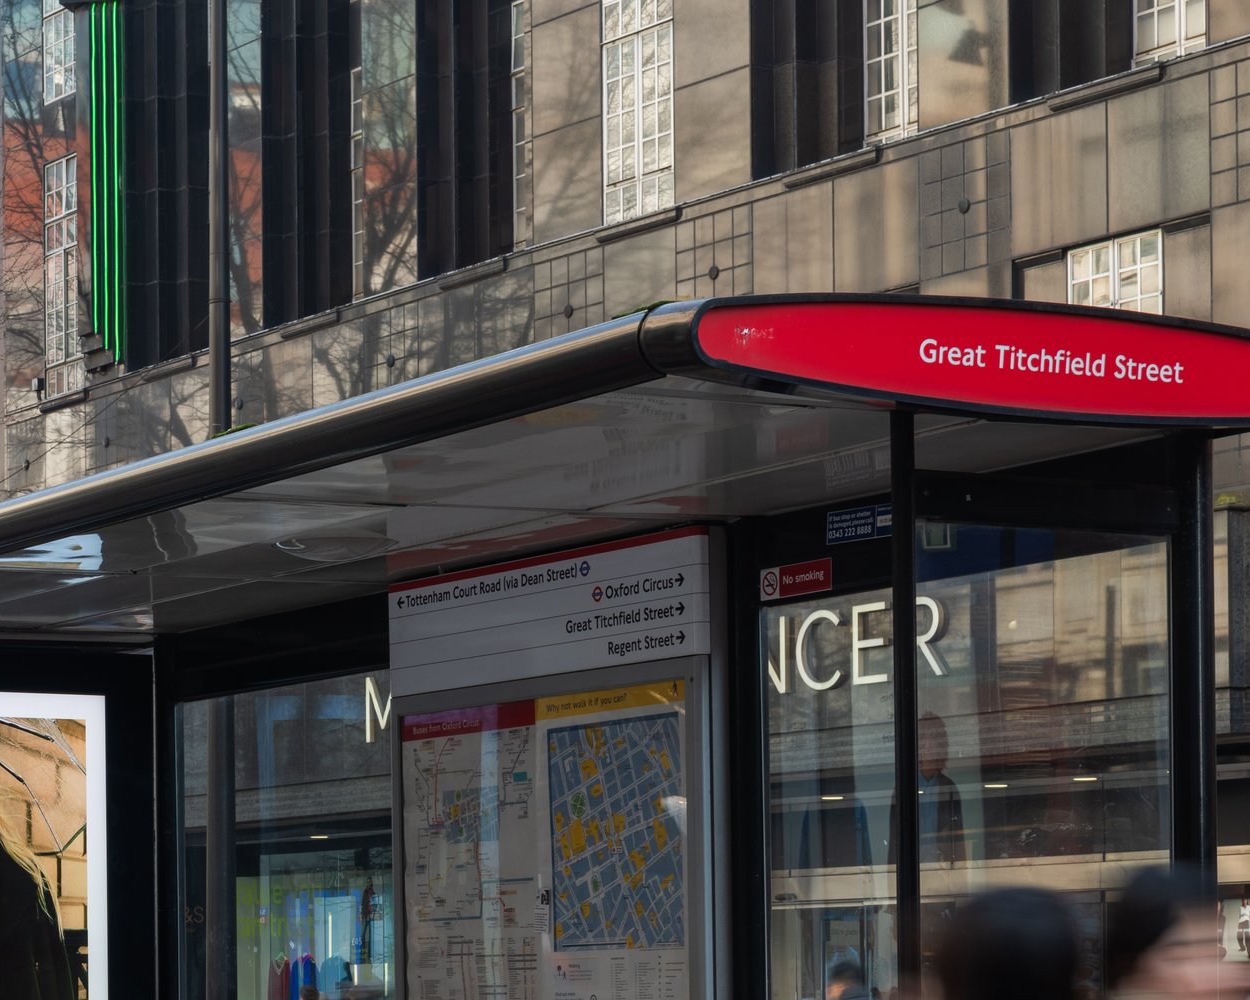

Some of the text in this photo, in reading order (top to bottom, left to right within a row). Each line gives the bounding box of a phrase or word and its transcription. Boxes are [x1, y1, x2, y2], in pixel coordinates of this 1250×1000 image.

[919, 338, 1184, 384] Great Titchfield Street
[829, 525, 872, 539] 0343 222 8888
[405, 562, 578, 609] Tottenham Court Road (via Dean Street)
[605, 574, 674, 599] Oxford Circus
[782, 568, 825, 586] No smoking
[565, 604, 674, 634] Great Titchfield Street
[607, 633, 675, 656] Regent Street
[768, 596, 945, 694] NCER
[546, 703, 559, 714] Why
[560, 702, 571, 712] not
[573, 700, 588, 710] walk
[599, 697, 612, 708] you
[412, 718, 480, 736] Buses from Oxford Circus
[184, 905, 205, 924] &S
